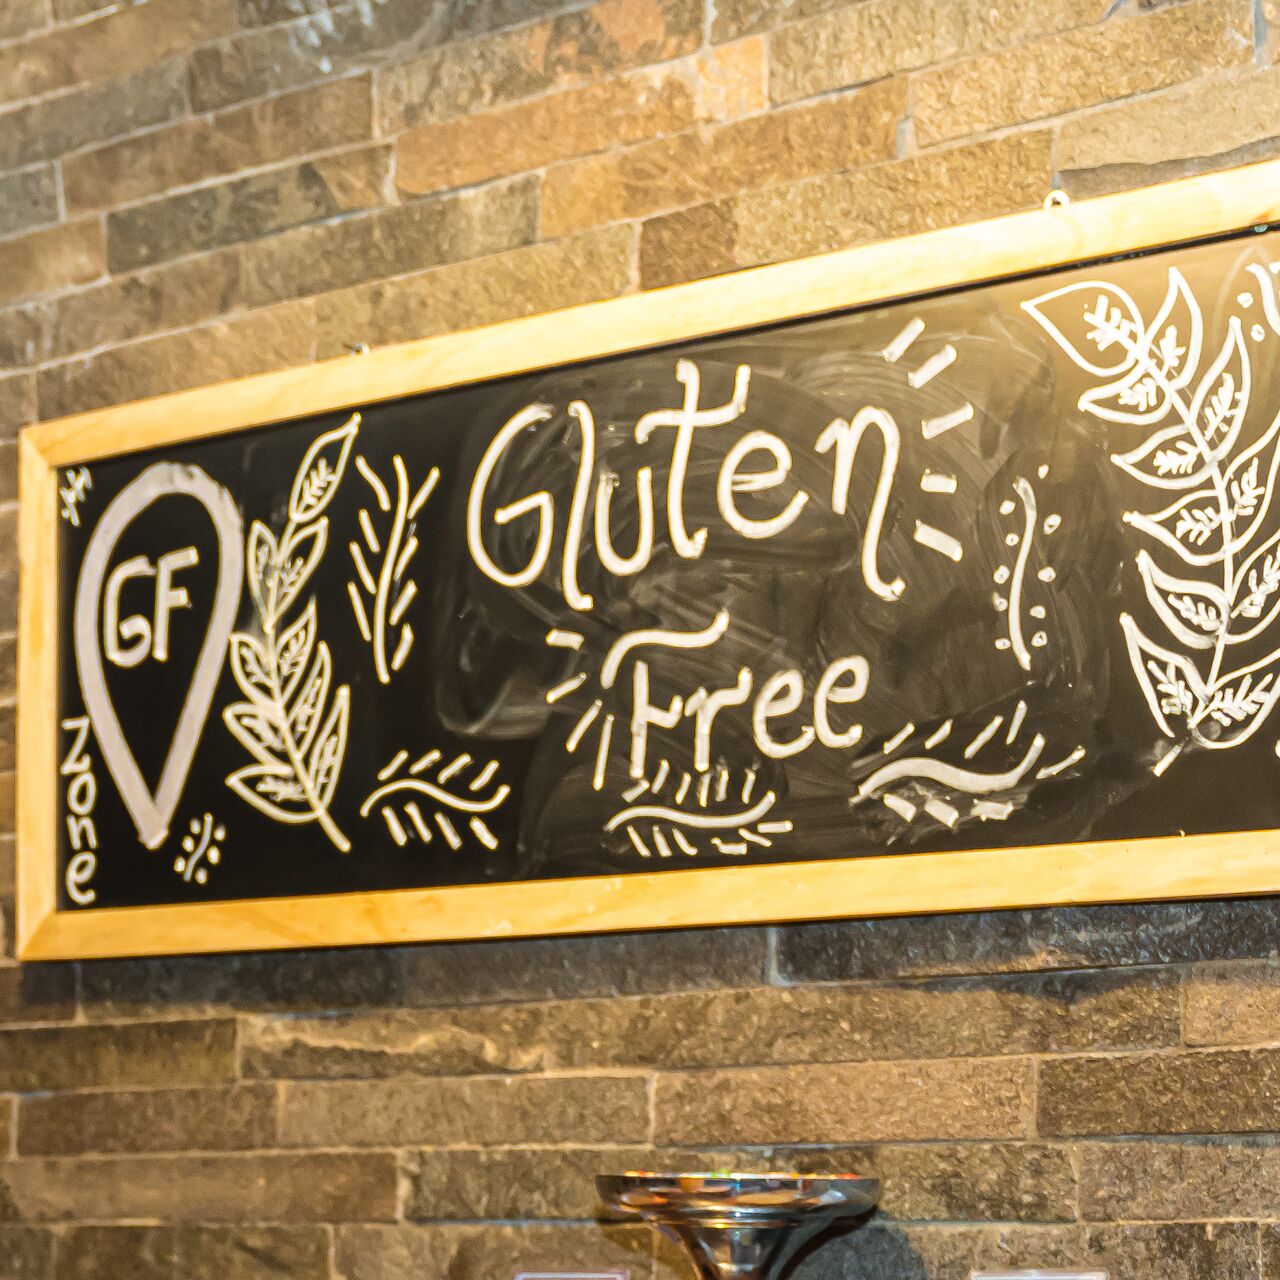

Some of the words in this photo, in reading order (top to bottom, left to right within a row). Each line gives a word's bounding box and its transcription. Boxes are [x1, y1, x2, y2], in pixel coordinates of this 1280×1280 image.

[467, 359, 906, 610] Gluten
[103, 547, 199, 667] GF
[600, 609, 870, 778] Free
